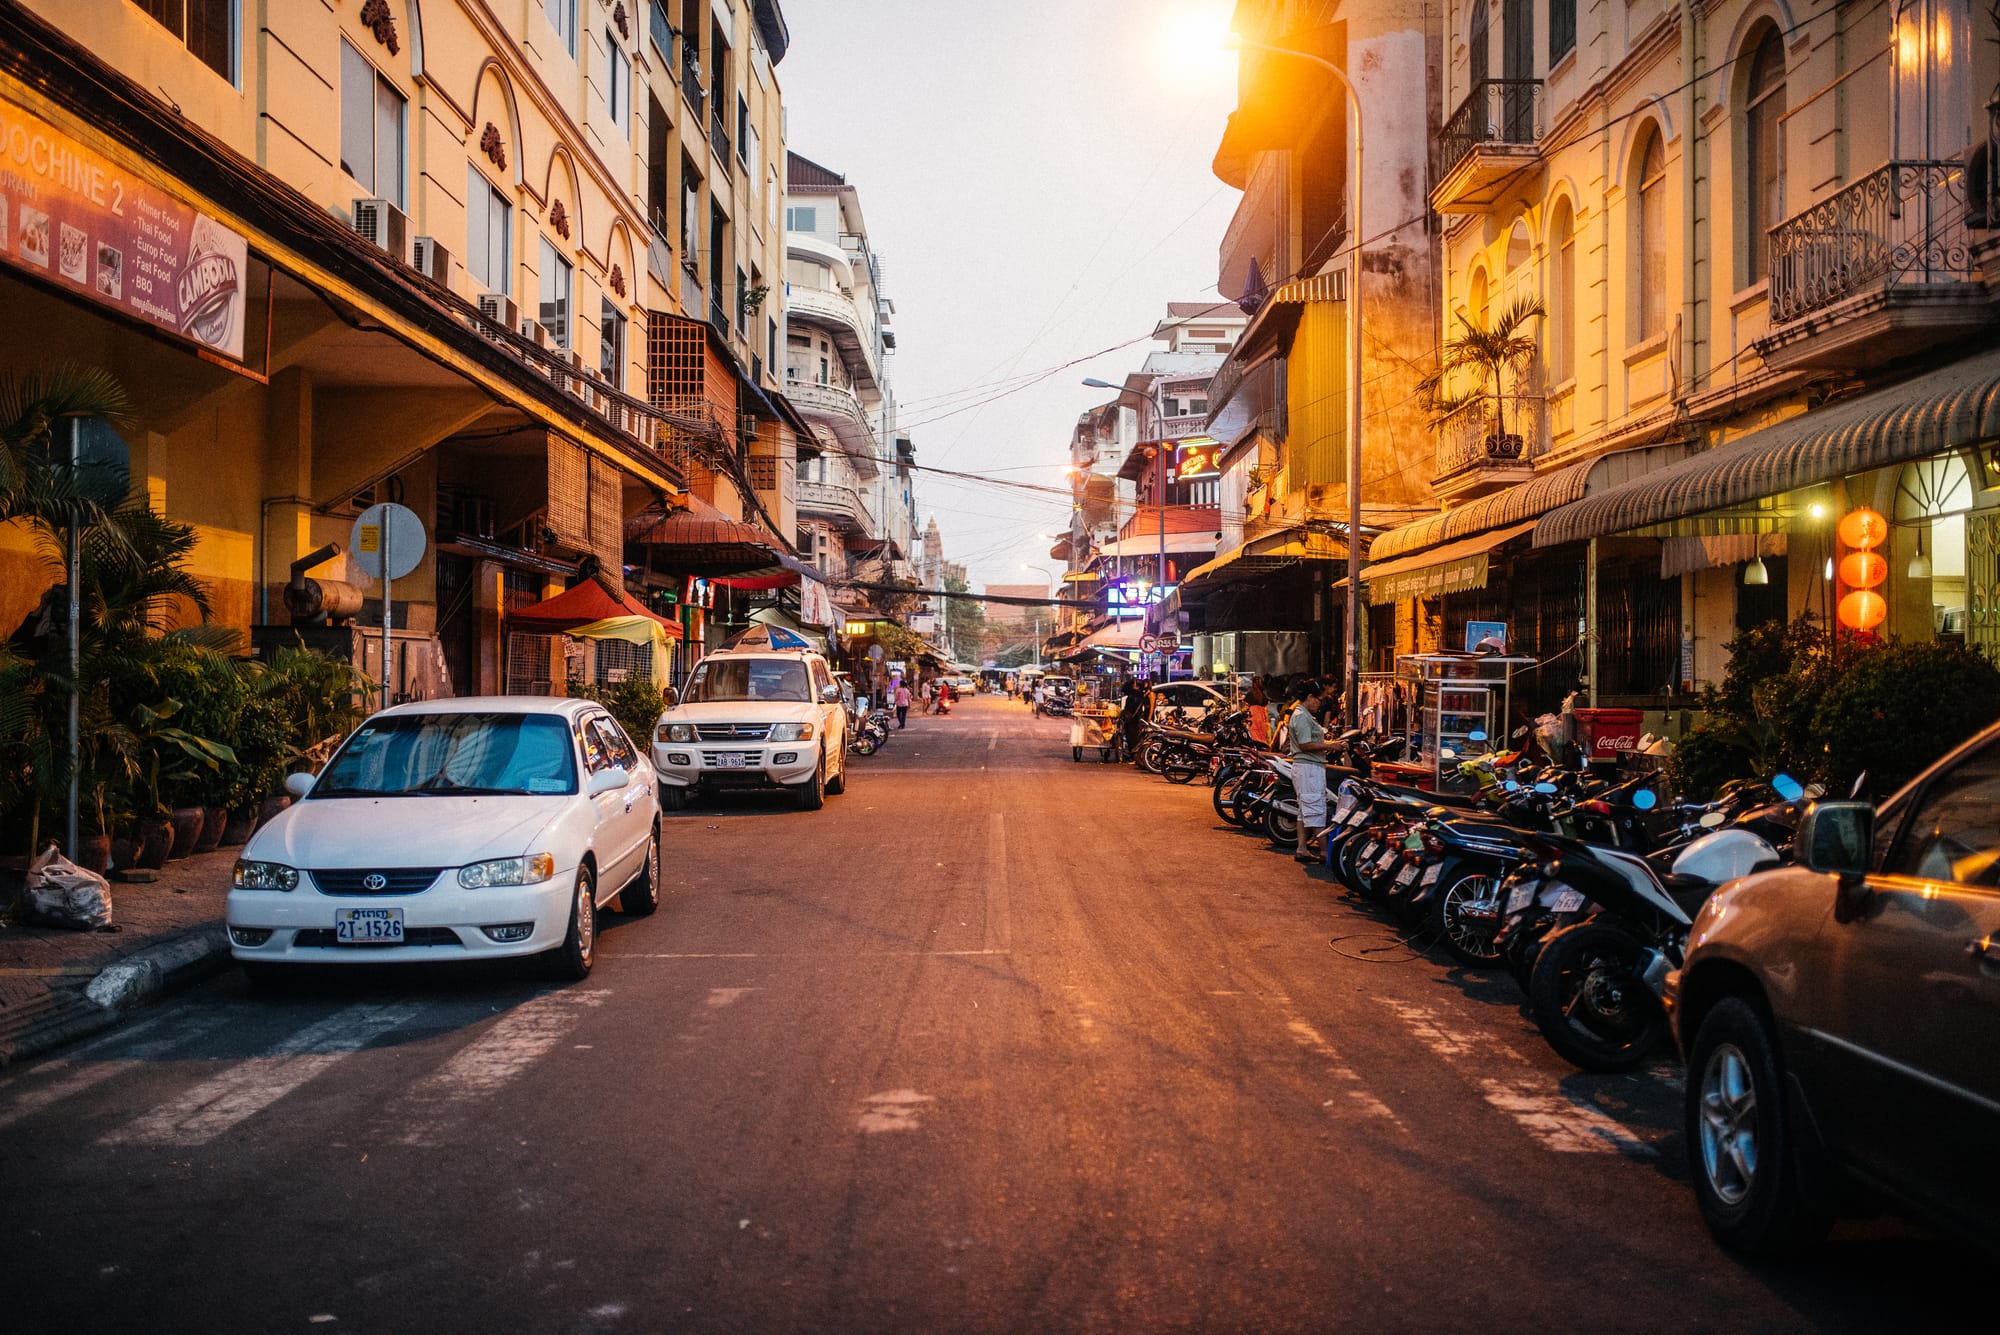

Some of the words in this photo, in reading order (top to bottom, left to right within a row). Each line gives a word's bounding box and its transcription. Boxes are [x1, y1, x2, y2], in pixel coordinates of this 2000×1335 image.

[111, 180, 124, 217] 2
[137, 196, 161, 218] Khmer
[162, 210, 180, 231] Food
[137, 216, 153, 235] Thai
[154, 225, 172, 245] Food
[137, 236, 158, 259] Europ
[160, 247, 177, 267] Food
[135, 274, 153, 294] BBQ
[136, 255, 152, 273] Fast
[153, 263, 171, 283] Food
[179, 258, 236, 313] CAMBODIA
